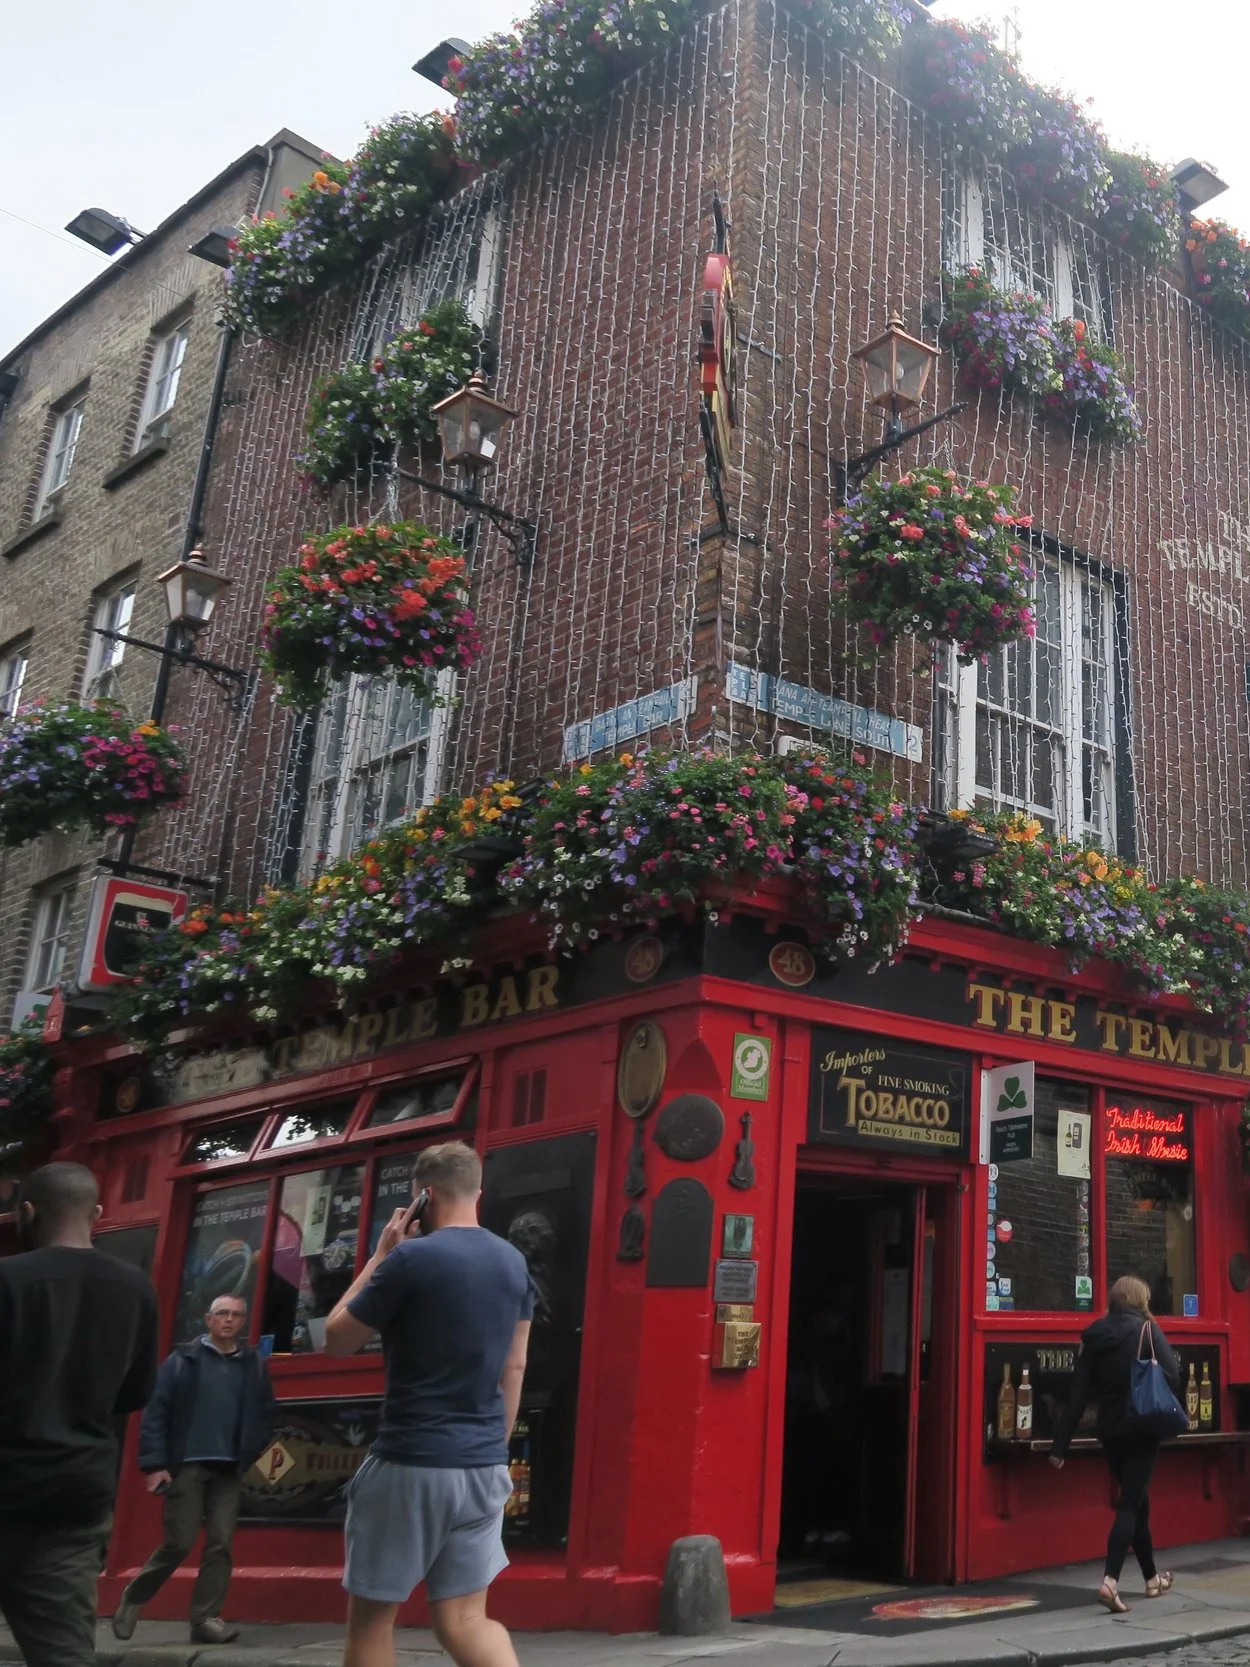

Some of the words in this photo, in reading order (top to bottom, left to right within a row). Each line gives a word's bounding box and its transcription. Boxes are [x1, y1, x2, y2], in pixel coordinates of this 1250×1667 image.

[820, 714, 850, 736] LANE
[777, 948, 806, 975] 48
[272, 998, 438, 1074] TEMPLE
[461, 965, 559, 1028] BAR
[968, 983, 1078, 1043] THE
[820, 1048, 886, 1076] Importers
[861, 1065, 873, 1075] OF
[878, 1074, 901, 1089] FINE
[904, 1079, 950, 1096] SMOKING
[837, 1076, 950, 1128] TOBACCO
[860, 1120, 904, 1137] Always
[909, 1125, 920, 1140] in
[924, 1127, 958, 1144] Stock
[1106, 1107, 1185, 1133] Traditional
[1105, 1131, 1141, 1155] Irish
[1147, 1135, 1189, 1161] Music
[381, 1165, 409, 1180] CATCH
[379, 1184, 388, 1197] IN
[389, 1180, 409, 1195] THE
[204, 1212, 218, 1225] THE
[220, 1207, 249, 1224] TEMPLE
[251, 1204, 268, 1218] BAR
[1037, 1350, 1074, 1372] THE
